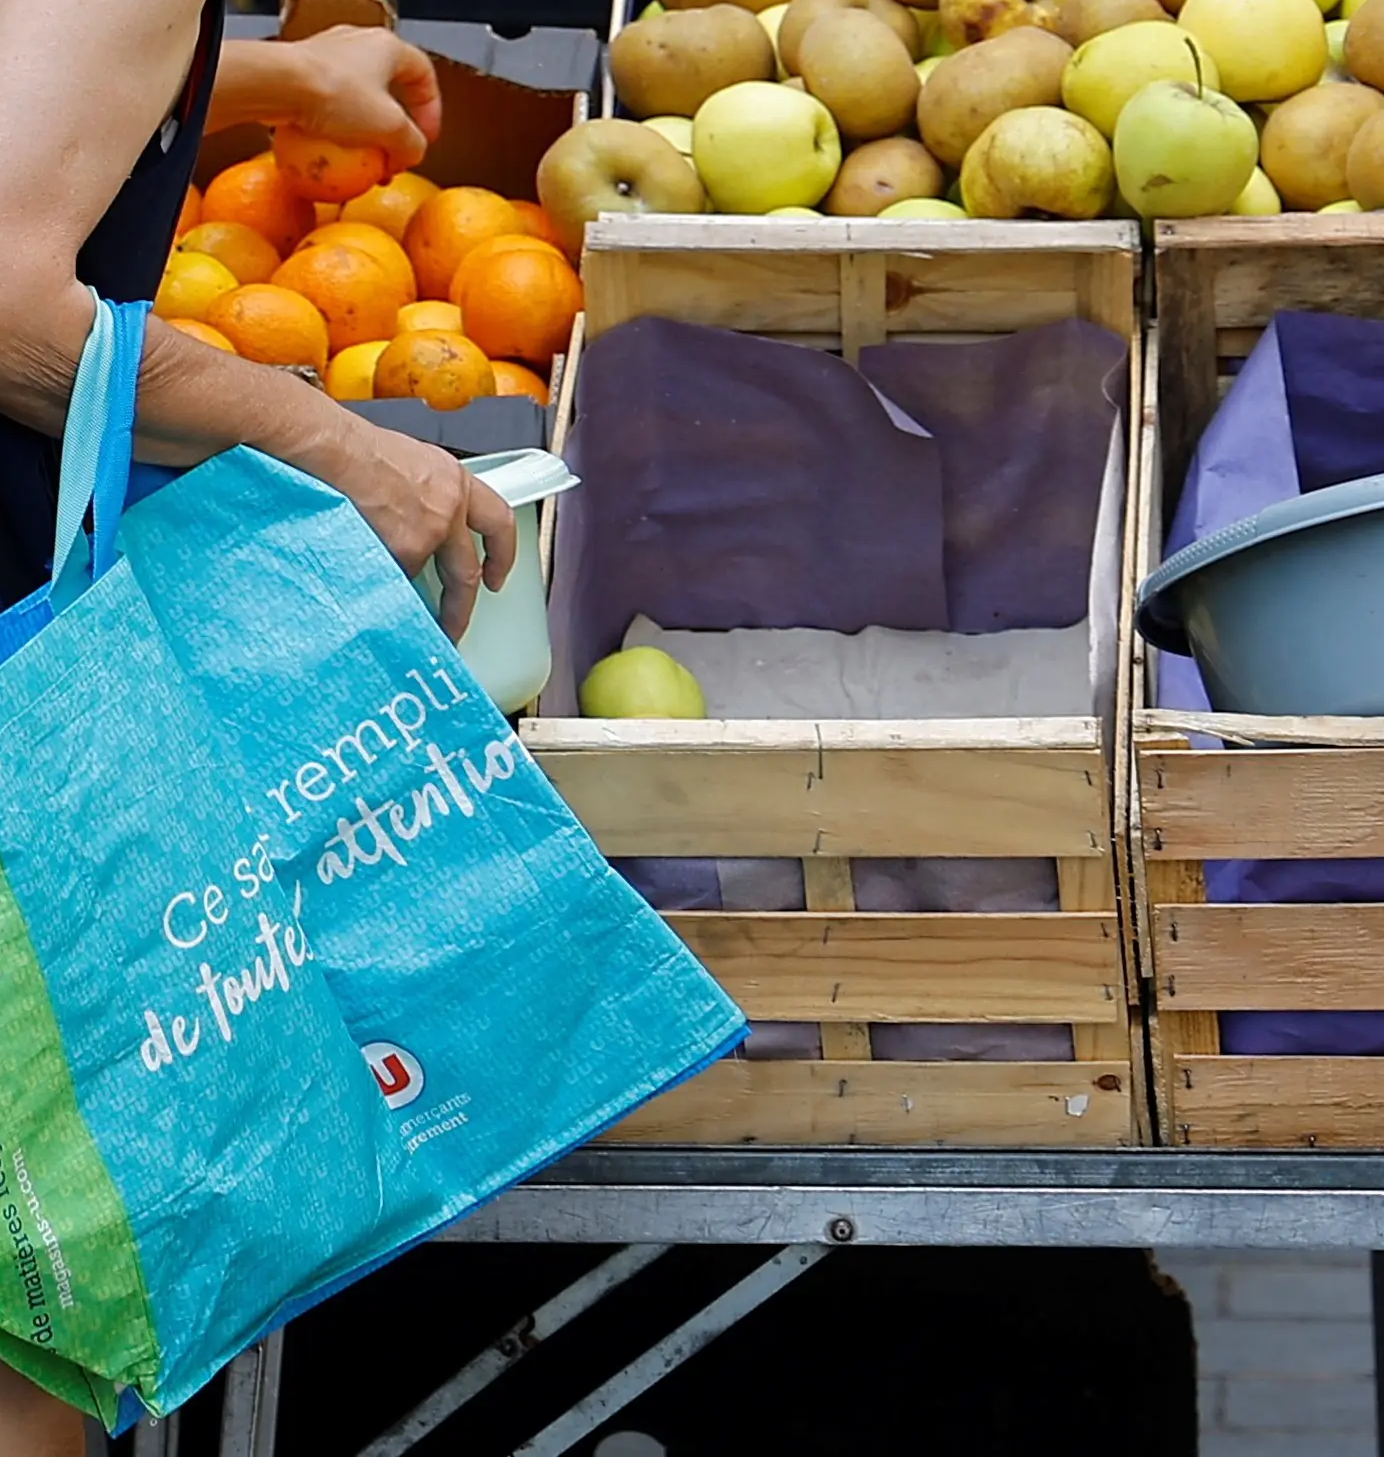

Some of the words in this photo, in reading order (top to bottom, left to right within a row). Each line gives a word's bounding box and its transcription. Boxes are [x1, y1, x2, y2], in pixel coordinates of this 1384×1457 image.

[163, 883, 229, 949] Ce
[266, 656, 469, 824] rempli
[139, 1010, 200, 1072] de
[3, 1204, 46, 1310] matières
[12, 1148, 75, 1310] magasins-u.com
[30, 1313, 53, 1344] de
